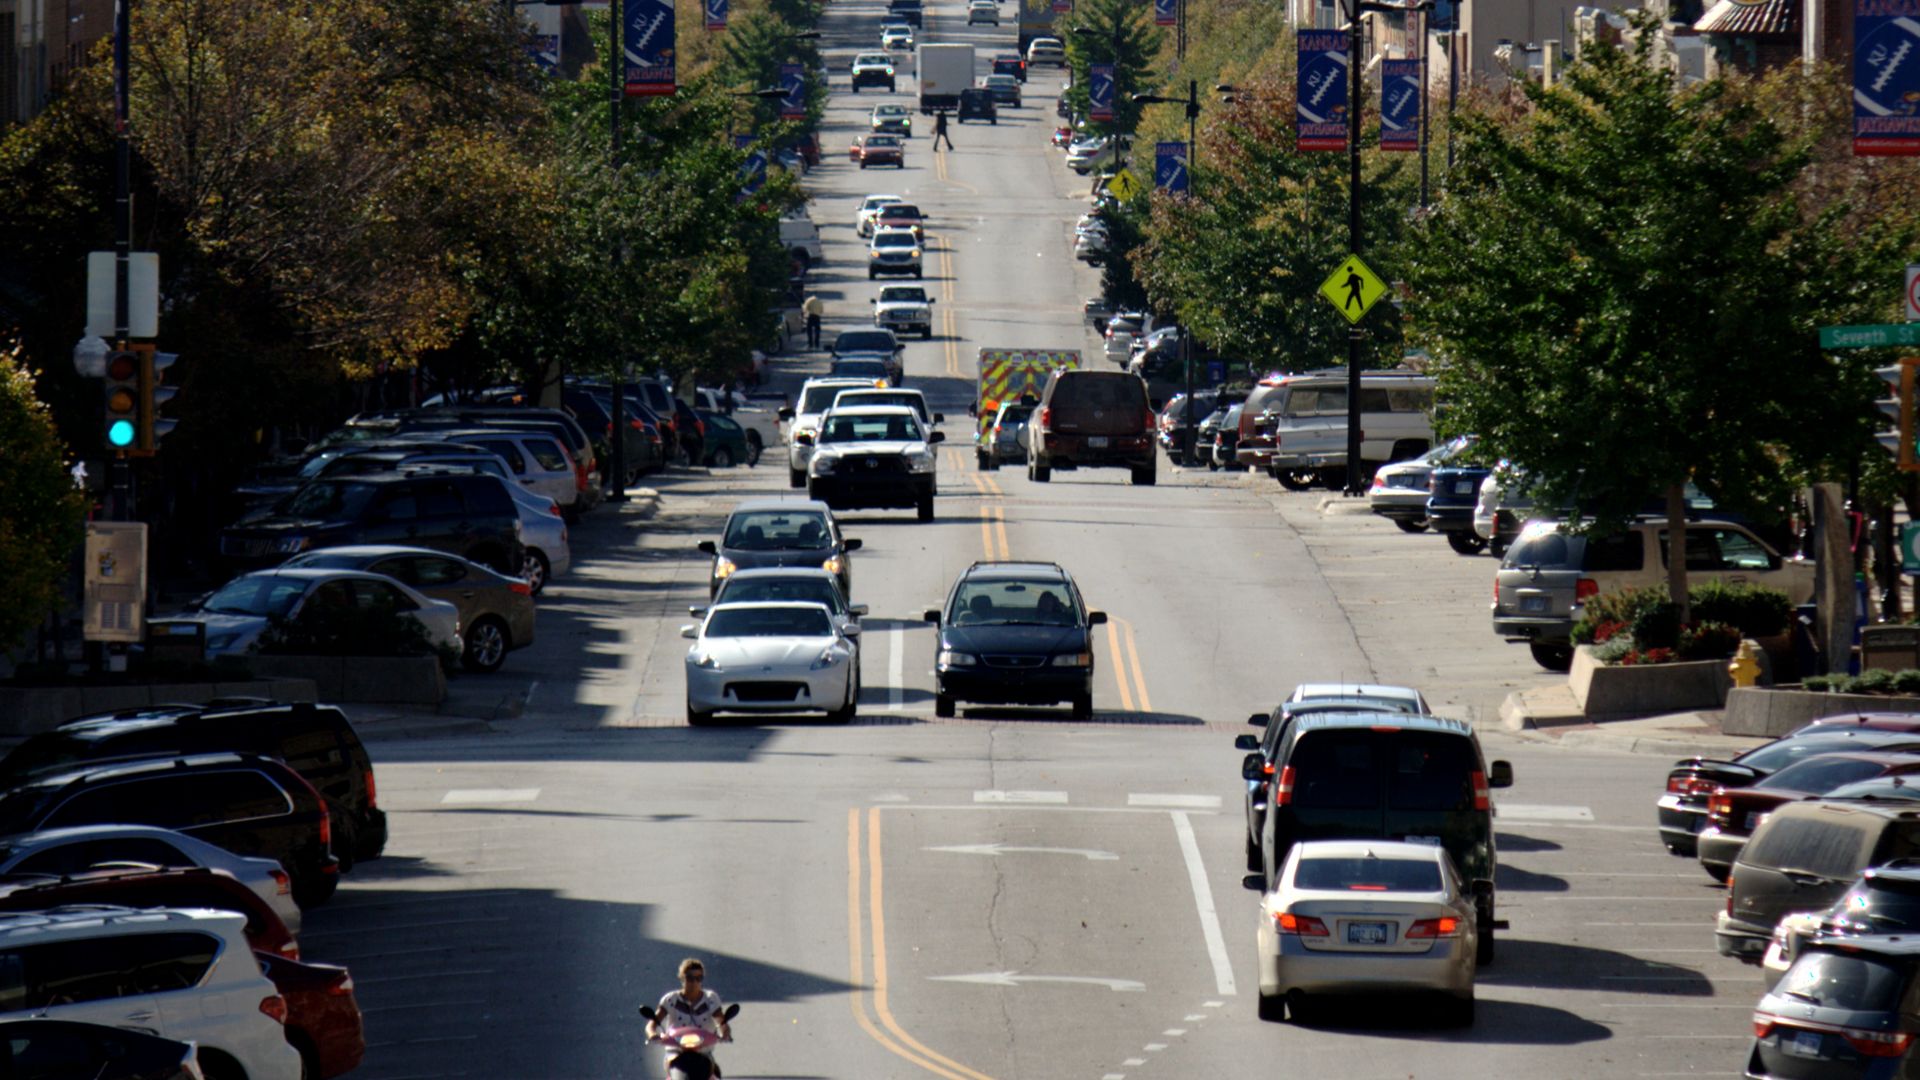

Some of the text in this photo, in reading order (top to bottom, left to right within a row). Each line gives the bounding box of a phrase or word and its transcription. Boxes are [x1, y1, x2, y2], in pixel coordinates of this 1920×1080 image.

[632, 13, 648, 31] KU
[1298, 34, 1349, 51] KANSAS
[1866, 43, 1888, 67] KU
[1307, 70, 1322, 88] KU
[1832, 327, 1916, 345] Seventh St
